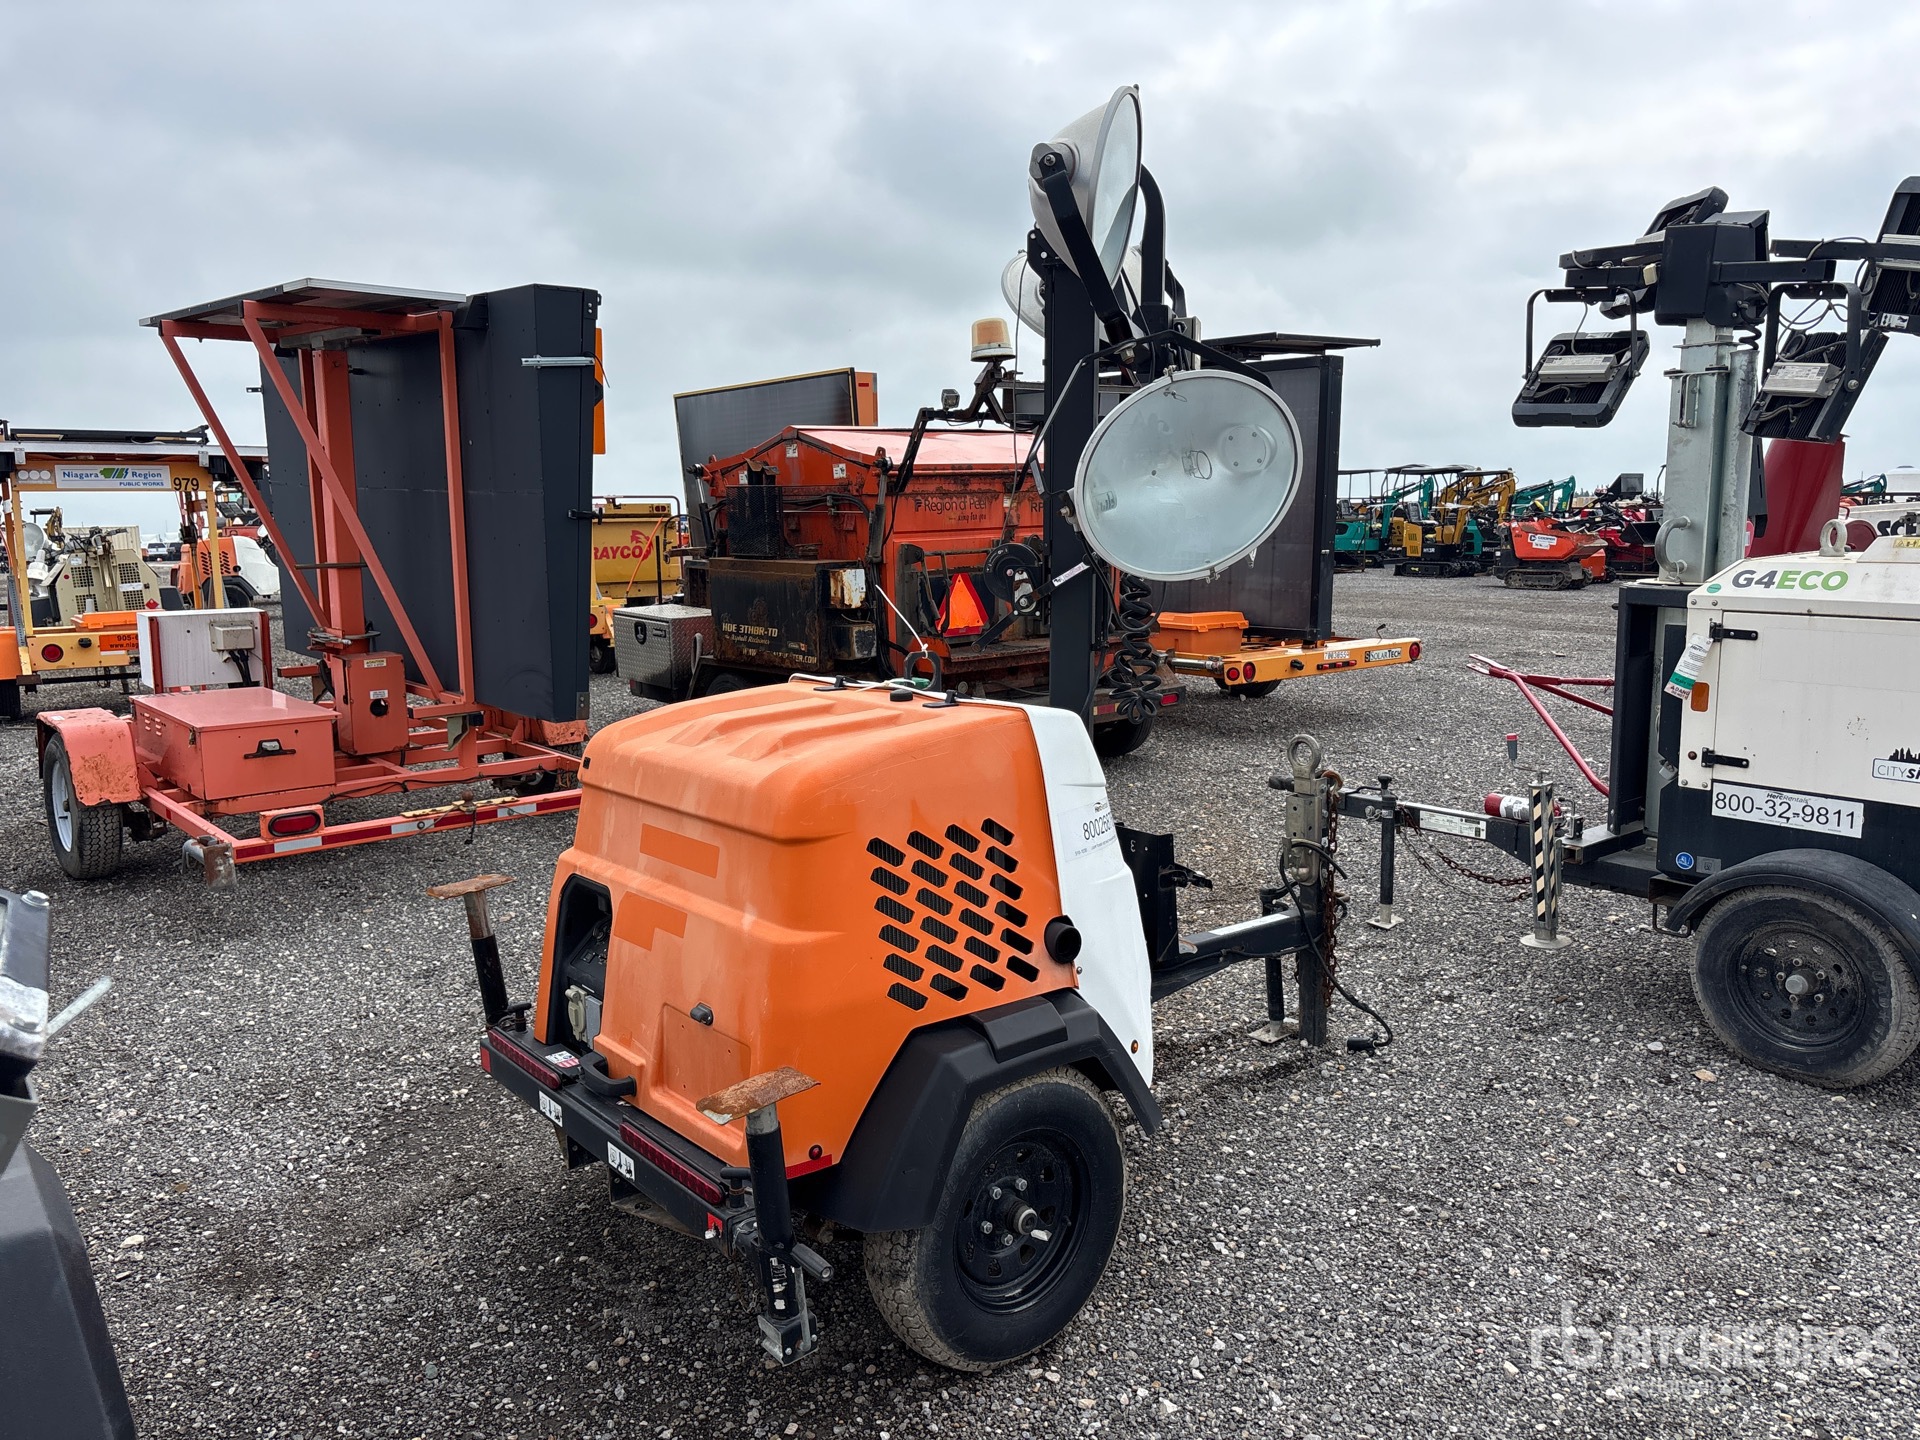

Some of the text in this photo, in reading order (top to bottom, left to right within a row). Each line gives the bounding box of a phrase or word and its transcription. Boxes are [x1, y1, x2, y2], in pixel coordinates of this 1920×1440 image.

[63, 470, 162, 480] Niagara Region
[173, 477, 199, 491] 979
[924, 498, 958, 515] Region
[969, 496, 987, 510] Peel
[593, 545, 643, 560] RAYCO
[1731, 569, 1849, 591] G4ECO
[1714, 792, 1854, 829] 800-32-9811
